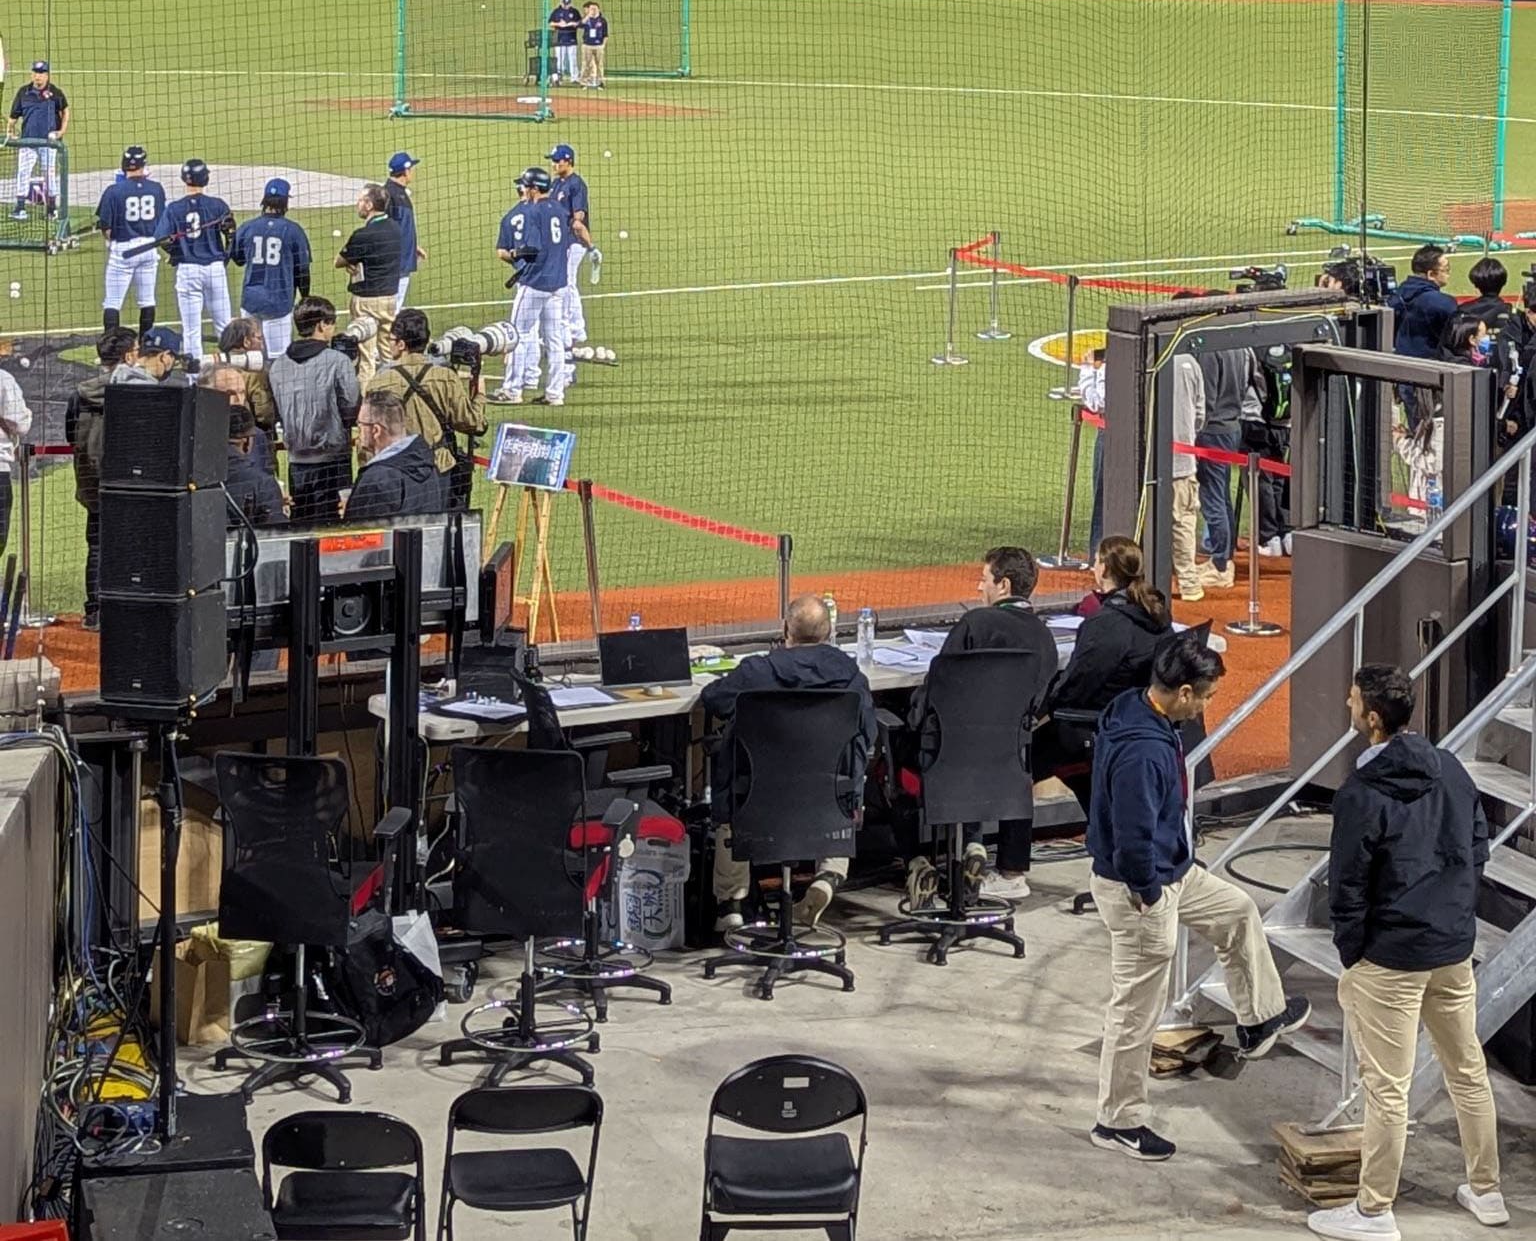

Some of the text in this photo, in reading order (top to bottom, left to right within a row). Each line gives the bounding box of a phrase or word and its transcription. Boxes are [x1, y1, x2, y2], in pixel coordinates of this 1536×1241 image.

[125, 195, 156, 222] 88
[186, 212, 201, 239] 3
[550, 216, 562, 244] 6
[252, 236, 283, 266] 18
